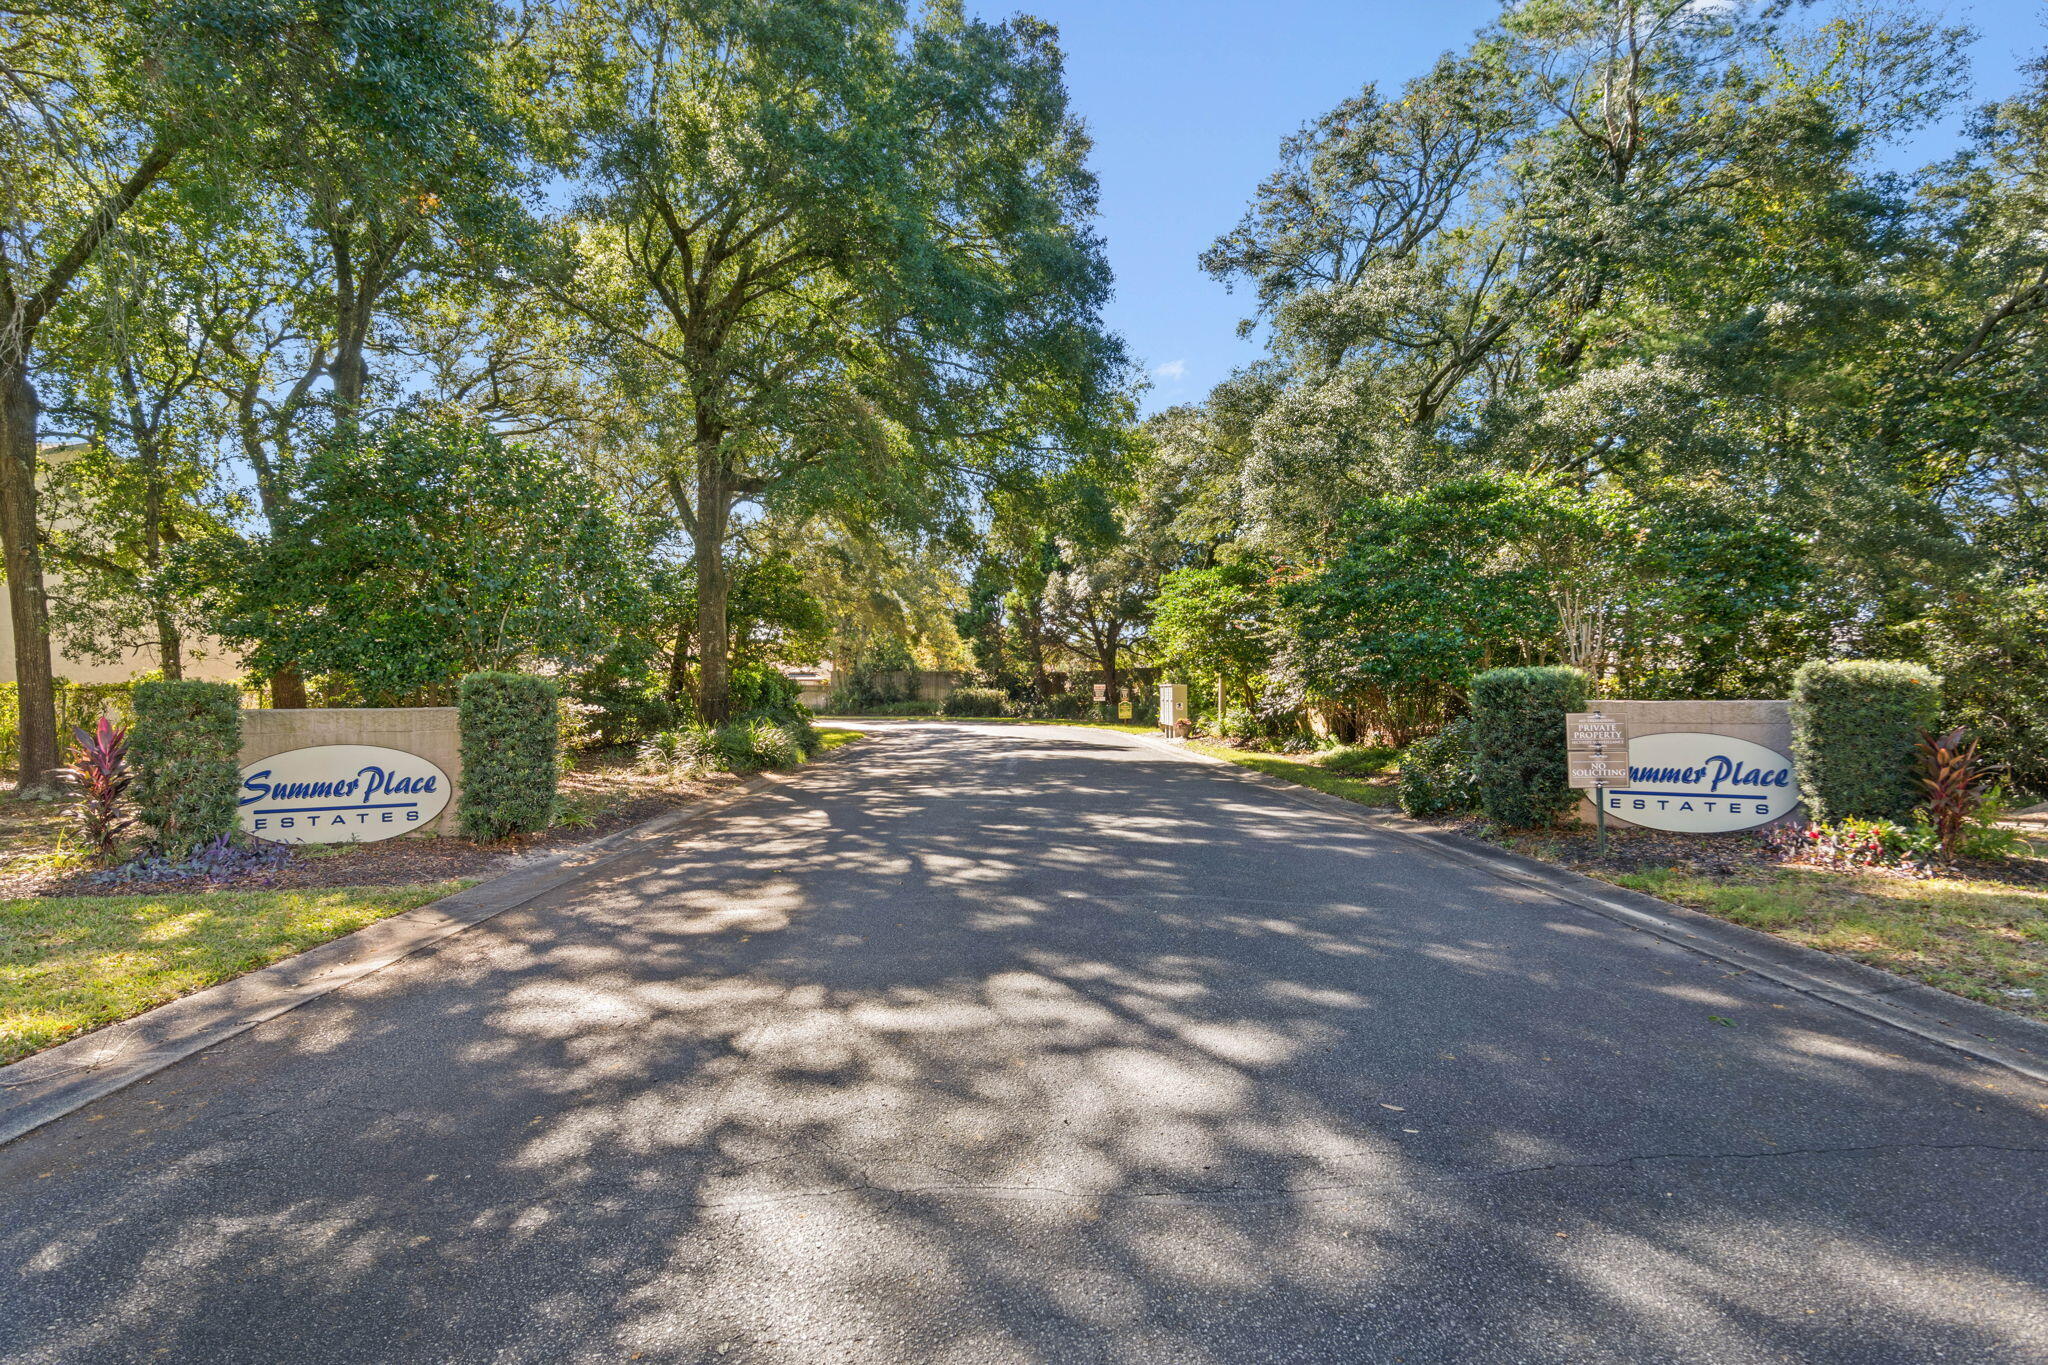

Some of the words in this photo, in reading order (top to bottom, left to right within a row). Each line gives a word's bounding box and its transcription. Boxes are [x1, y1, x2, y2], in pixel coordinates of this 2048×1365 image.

[1574, 731, 1621, 739] PROPERTY
[1578, 724, 1616, 732] PRIVATE
[1571, 769, 1626, 777] SOLICITING
[1629, 766, 1707, 784] ummer
[1705, 755, 1790, 792] Place
[239, 769, 358, 806] Summer
[358, 765, 437, 803] Place
[1610, 798, 1769, 814] ESTATES
[254, 811, 419, 830] ESTATES
